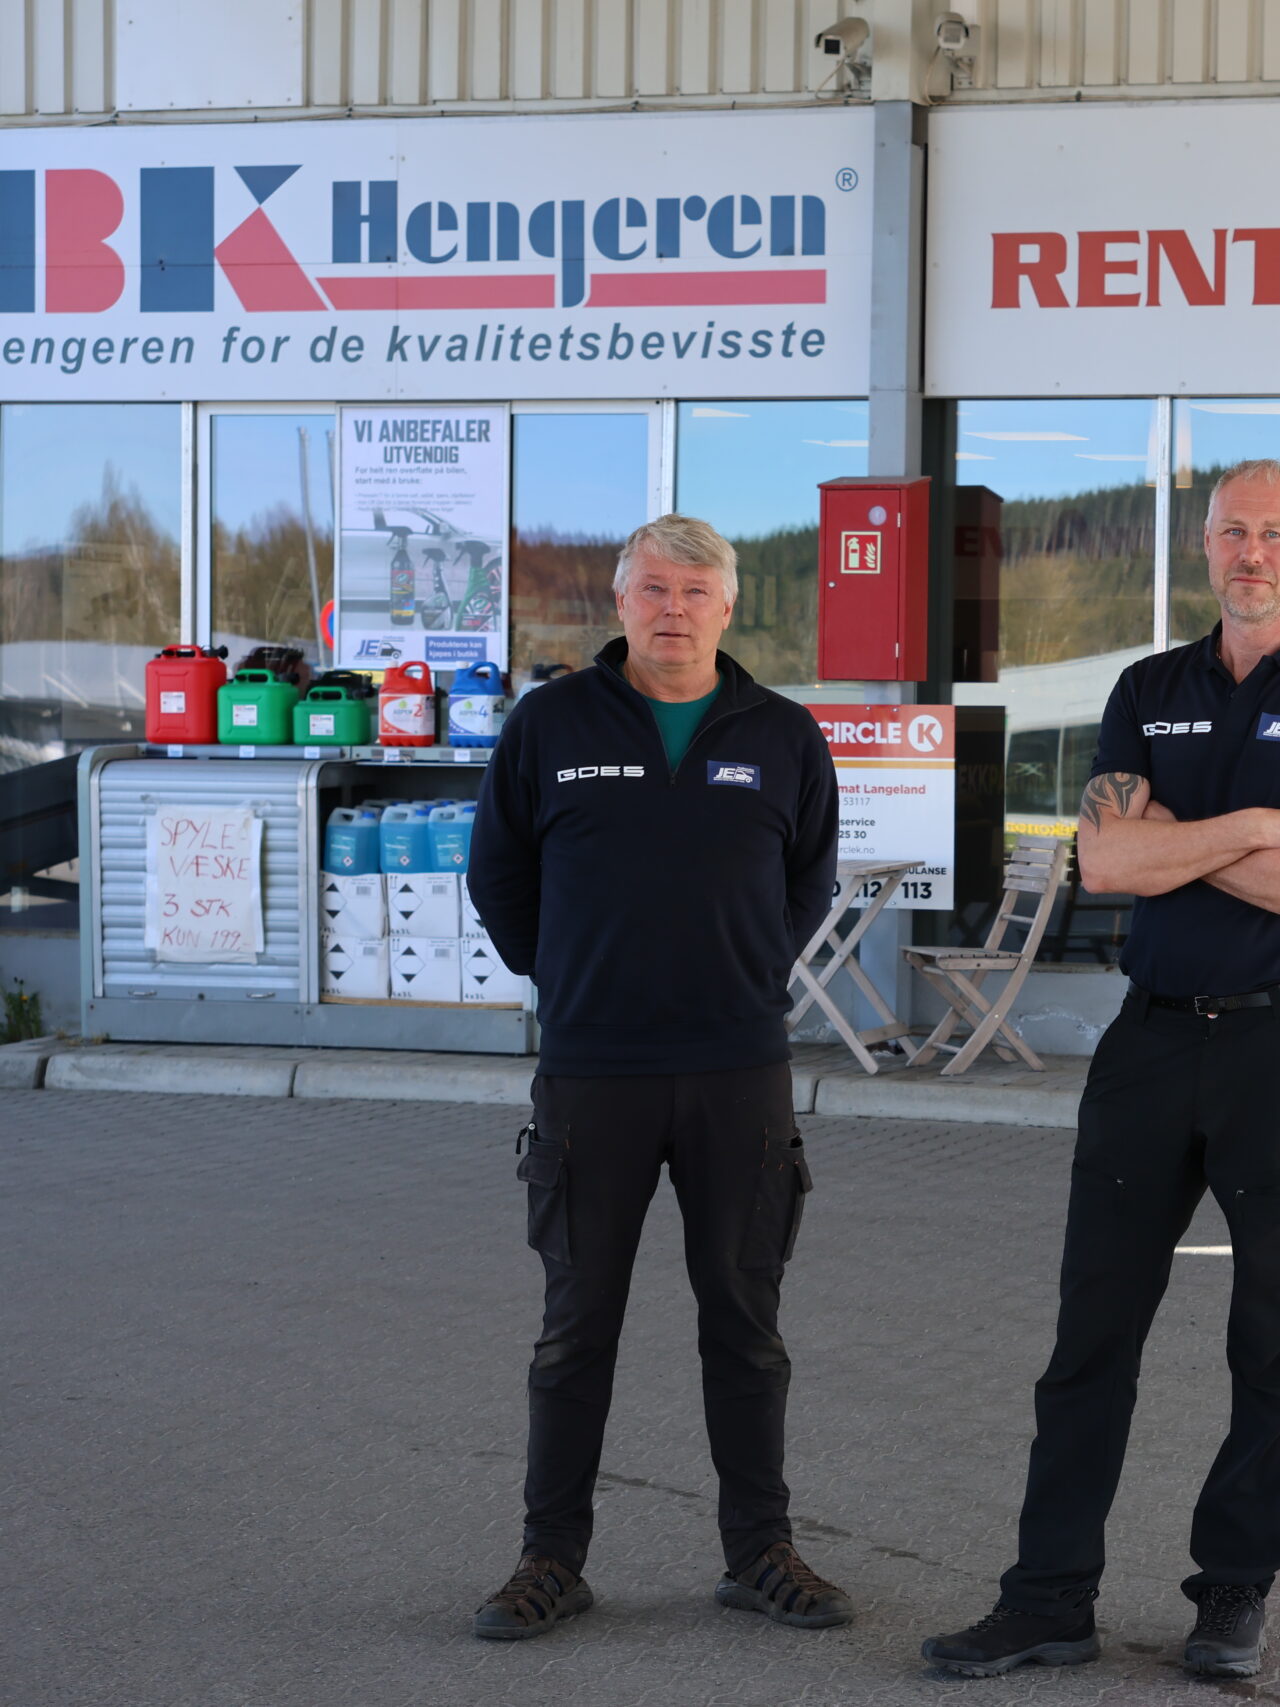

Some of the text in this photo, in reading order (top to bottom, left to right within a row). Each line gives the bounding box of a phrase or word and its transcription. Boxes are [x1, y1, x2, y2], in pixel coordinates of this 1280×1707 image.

[332, 180, 826, 308] Hengeren
[2, 321, 826, 375] engeren for de kvalitetsbevisste
[354, 419, 491, 443] VI ANBEFALER
[383, 446, 460, 464] UTVENDIG
[818, 721, 940, 750] CIRCLE K
[557, 765, 645, 783] GOES
[863, 784, 926, 796] Langeland
[843, 797, 871, 806] 53117
[839, 817, 876, 827] service
[838, 830, 867, 839] 25 30
[170, 854, 251, 880] VÆSKE
[901, 881, 932, 899] 113
[163, 893, 232, 918] 3 STK
[162, 925, 201, 948] KUN
